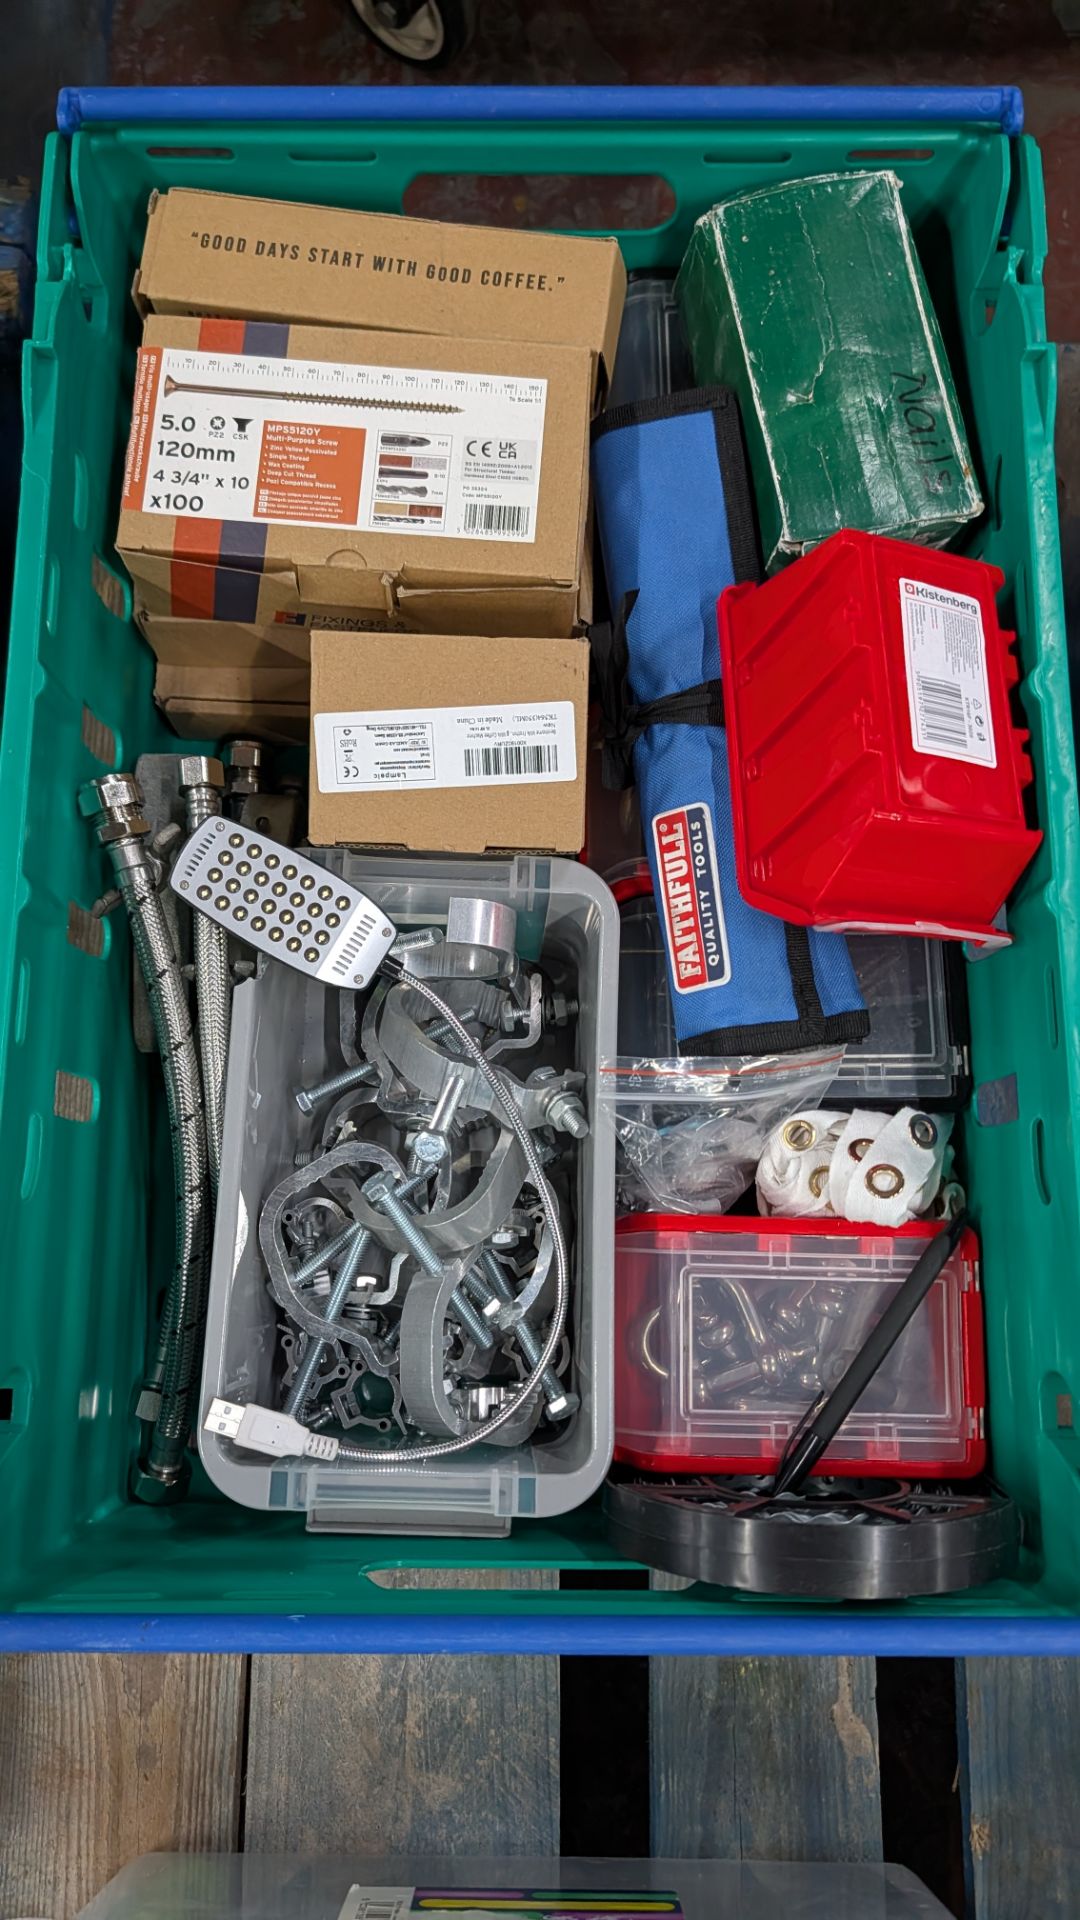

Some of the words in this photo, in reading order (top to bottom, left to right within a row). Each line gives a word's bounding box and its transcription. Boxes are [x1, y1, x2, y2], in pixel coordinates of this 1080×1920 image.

[255, 240, 300, 260] DAYS
[308, 247, 364, 268] START
[373, 255, 418, 277] WITH
[426, 263, 472, 284] GOOD
[160, 414, 196, 432] 5.0
[208, 431, 225, 439] PZ2
[267, 424, 321, 436] MPS5120Y
[890, 371, 954, 495] Nails
[266, 434, 315, 445] Multi-Purpose
[317, 438, 339, 446] Screw
[499, 441, 517, 451] UK
[157, 440, 235, 462] 120mm
[305, 447, 337, 456] Passivated
[466, 440, 493, 458] CE
[498, 451, 517, 460] CA
[289, 454, 309, 462] Thread
[282, 462, 305, 470] Coating
[153, 469, 165, 482] 4
[170, 470, 210, 486] 3/4"
[215, 477, 224, 488] x
[231, 476, 250, 490] 10
[296, 471, 316, 479] Thread
[281, 479, 313, 487] Compatible
[315, 480, 336, 489] Recess
[149, 493, 204, 512] x100
[915, 586, 977, 614] Kistenberg
[311, 615, 387, 628] FIXINGS
[395, 619, 406, 629] &
[339, 739, 358, 748] RoHS
[344, 765, 360, 778] CE
[690, 821, 707, 879] TOOLS
[699, 889, 720, 967] QUALITY
